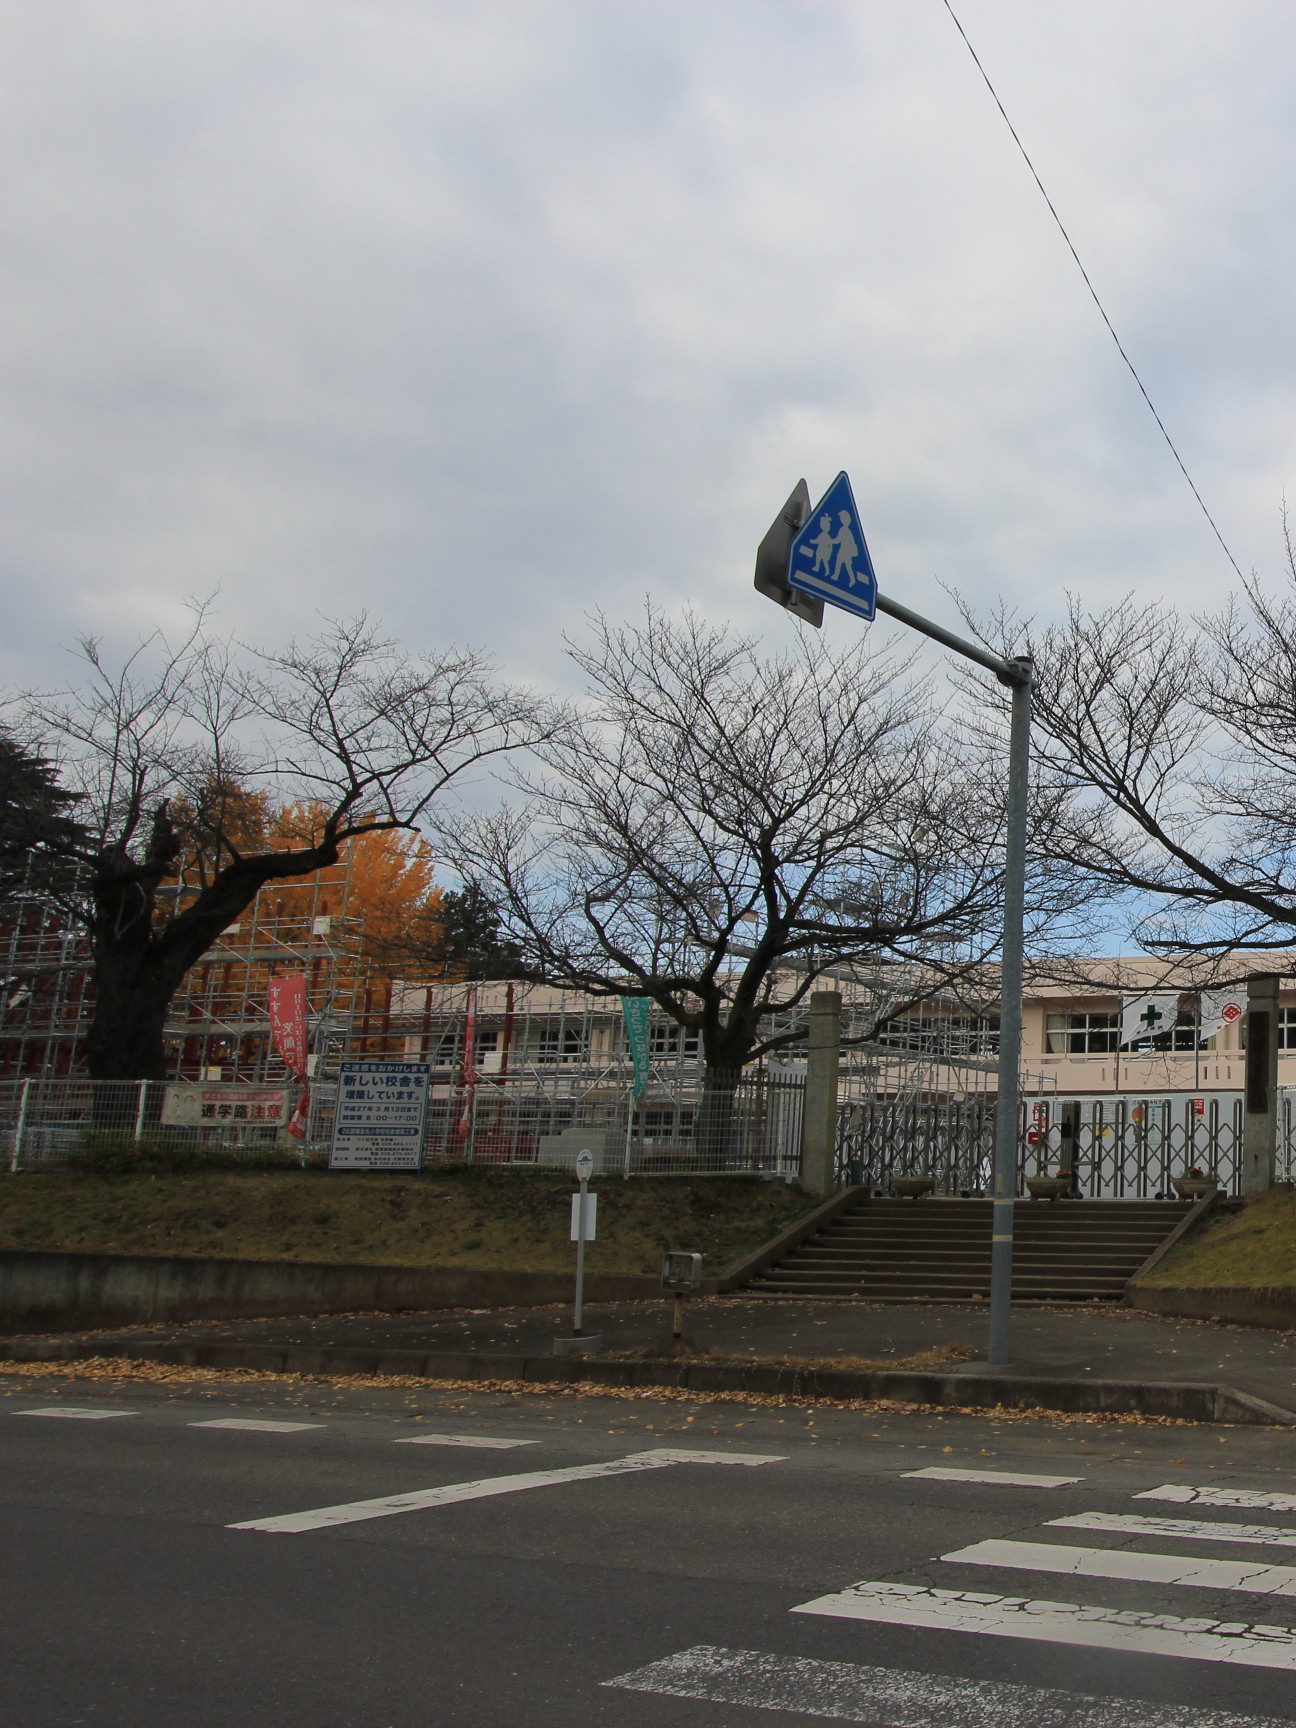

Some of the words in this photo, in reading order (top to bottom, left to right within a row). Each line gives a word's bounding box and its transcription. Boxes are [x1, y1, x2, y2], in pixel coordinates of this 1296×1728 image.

[343, 1064, 427, 1072] ご迷惑をおかけします
[343, 1074, 425, 1087] 新しい校舎を
[345, 1089, 420, 1100] 増築しています。
[201, 1103, 283, 1119] 通学路注意
